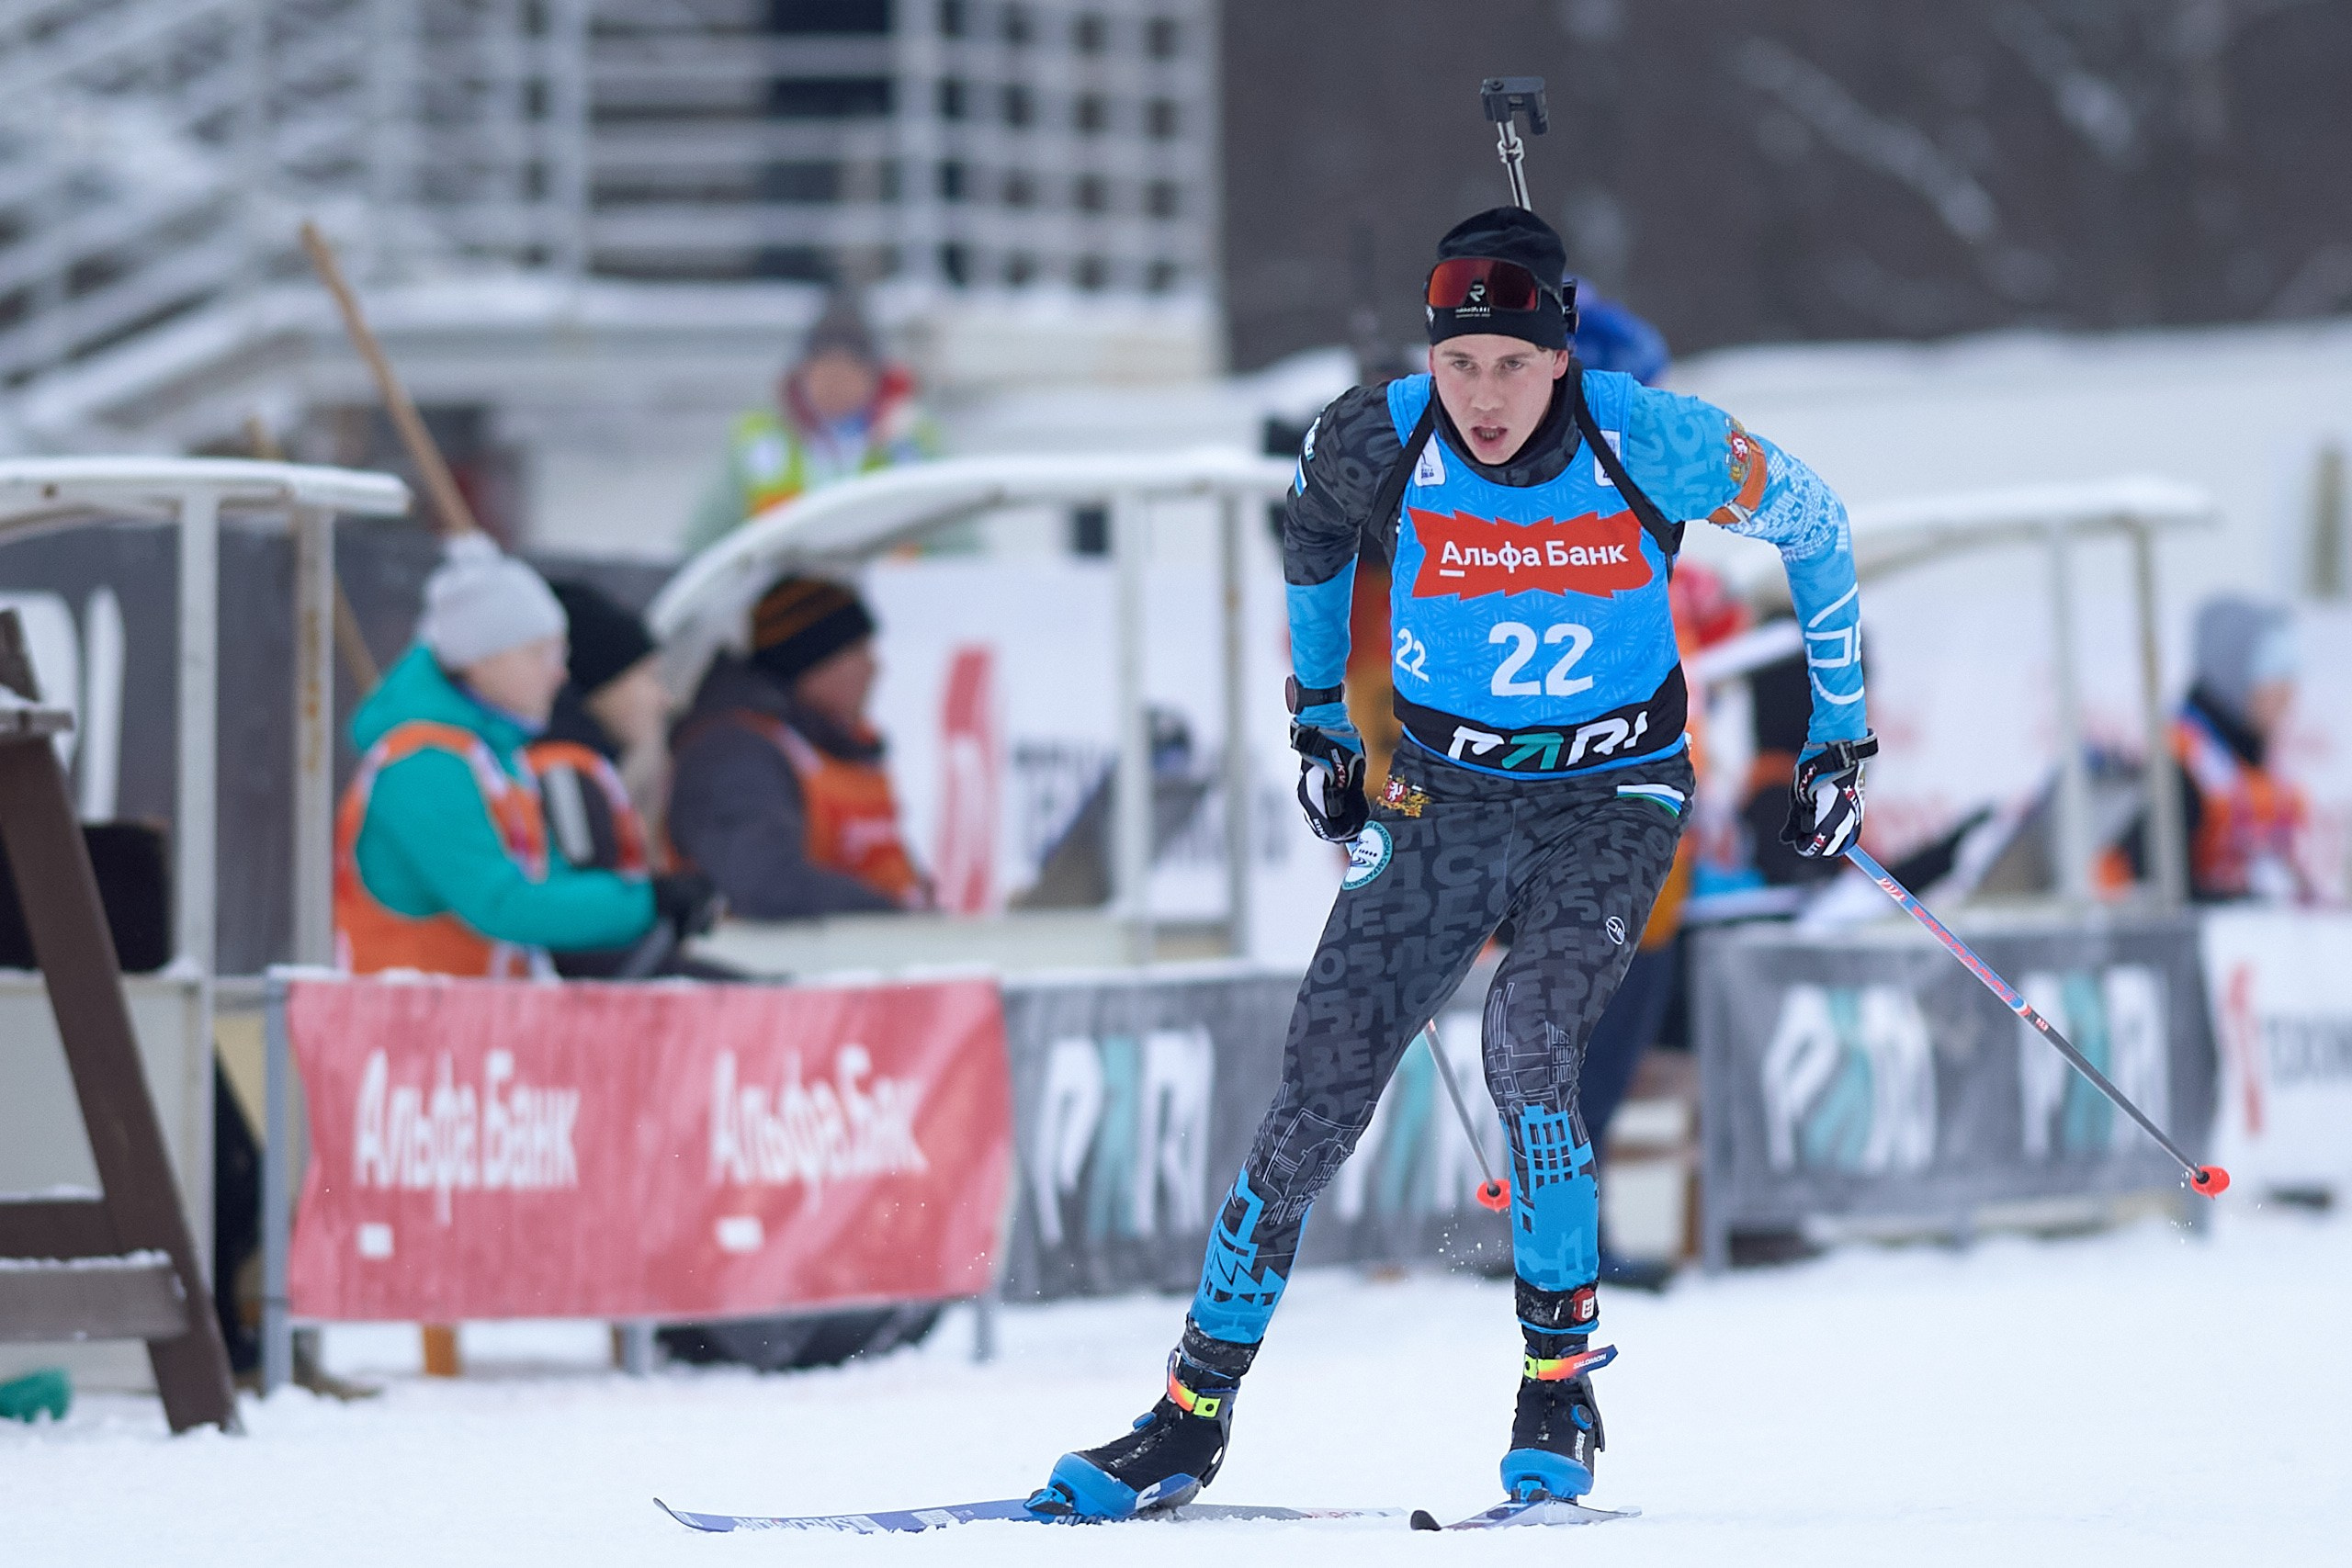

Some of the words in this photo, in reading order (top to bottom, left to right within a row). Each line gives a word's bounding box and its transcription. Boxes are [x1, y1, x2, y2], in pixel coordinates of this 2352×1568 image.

[1440, 540, 1542, 574] Альфа
[1544, 539, 1629, 567] Банк
[1396, 628, 1430, 682] 22
[1487, 621, 1594, 697] 22
[353, 1046, 480, 1225] Альфа
[483, 1048, 582, 1190] Банк
[709, 1047, 853, 1218] Альфа
[838, 1043, 928, 1182] Банк
[1572, 1352, 1608, 1371] SALOMON
